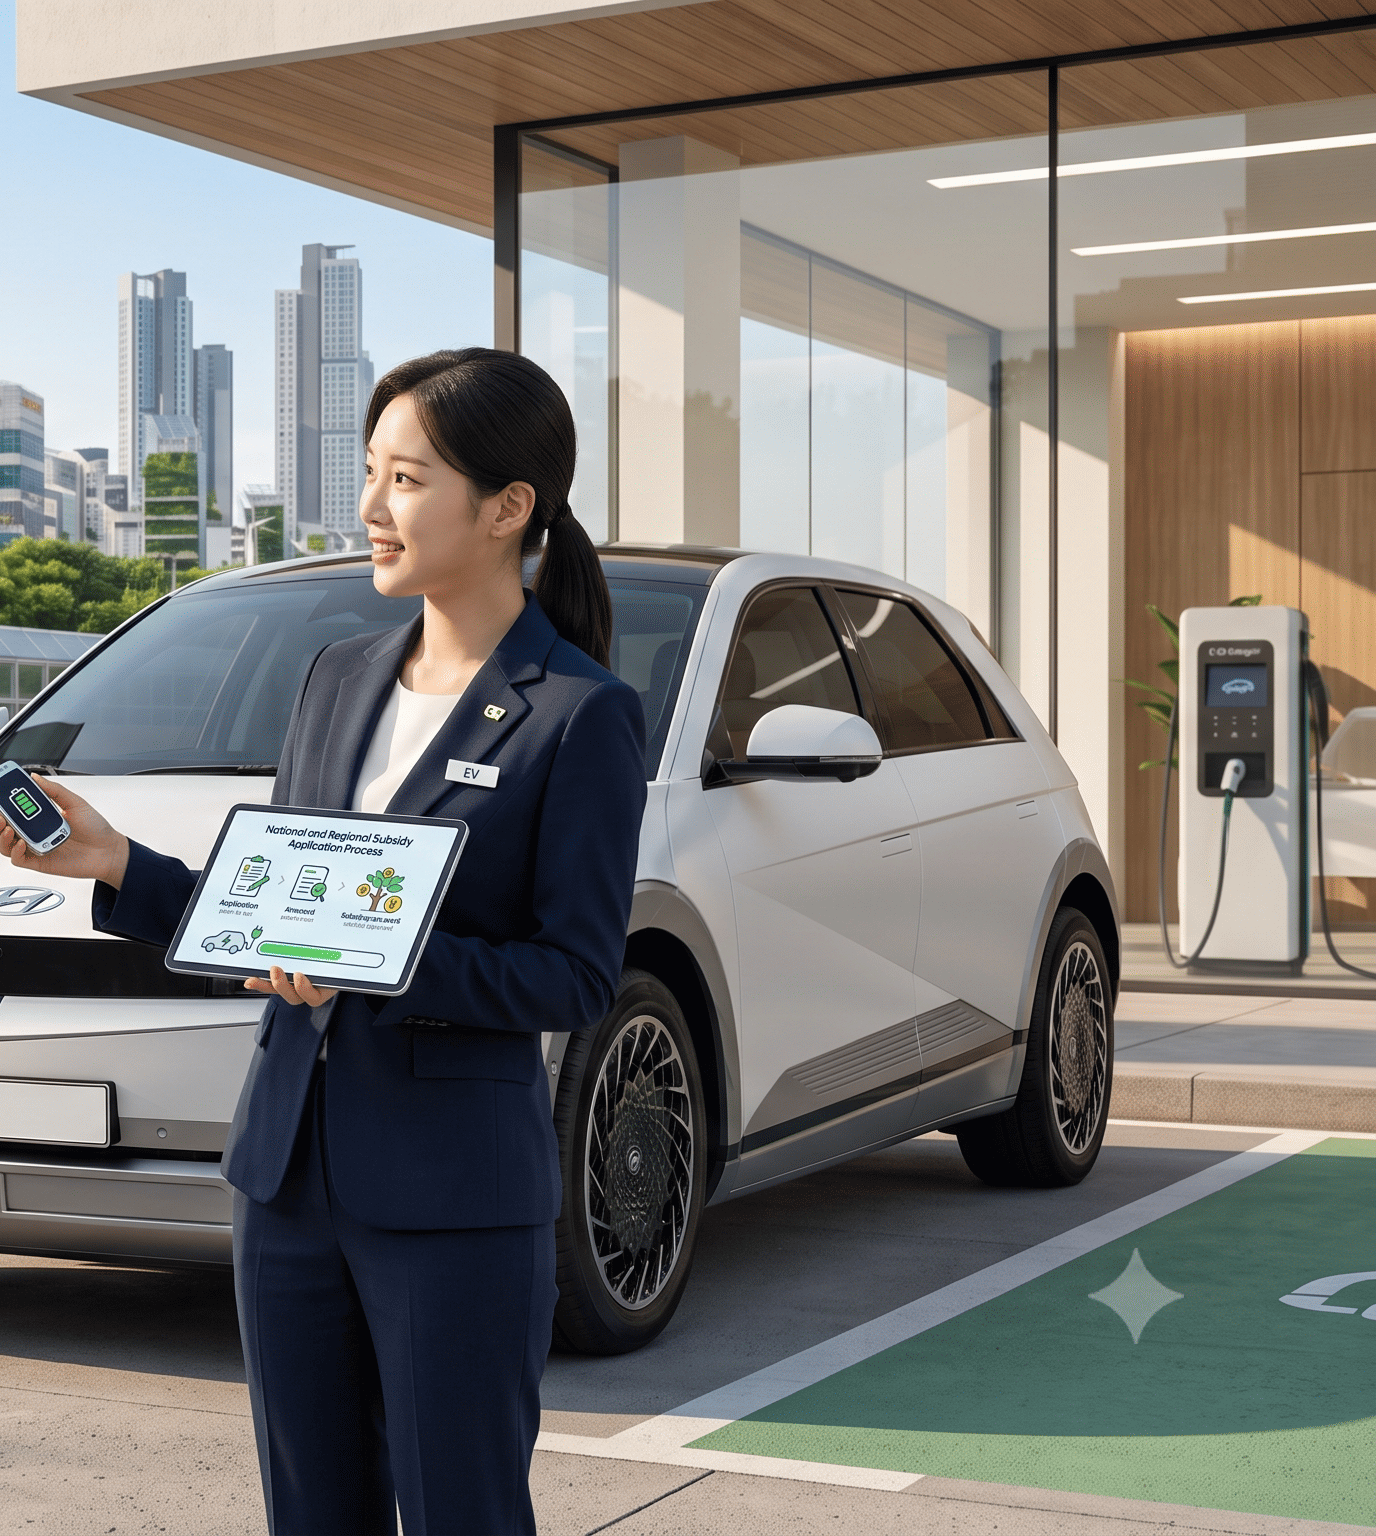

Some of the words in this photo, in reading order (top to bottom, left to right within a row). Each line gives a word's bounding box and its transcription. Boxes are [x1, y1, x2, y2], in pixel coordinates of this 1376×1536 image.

[463, 767, 480, 779] EV
[265, 824, 307, 837] National
[307, 829, 328, 839] and
[327, 830, 372, 843] Regional
[372, 833, 414, 848] Subsidy
[288, 839, 343, 853] Application
[343, 844, 384, 856] Process
